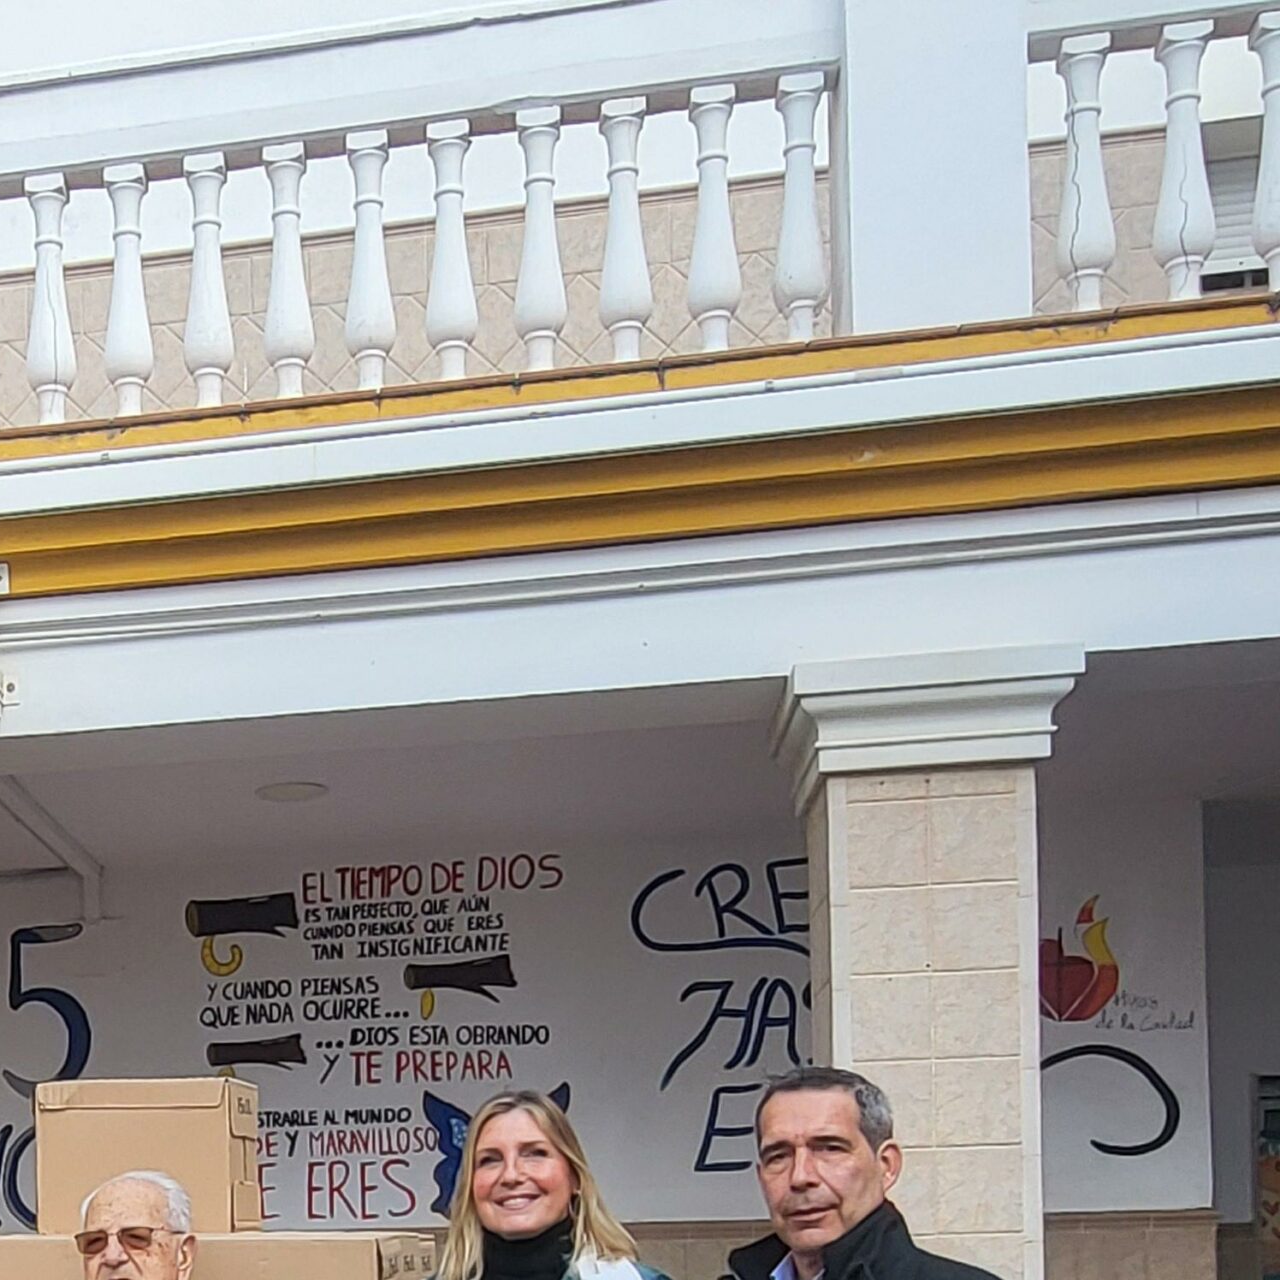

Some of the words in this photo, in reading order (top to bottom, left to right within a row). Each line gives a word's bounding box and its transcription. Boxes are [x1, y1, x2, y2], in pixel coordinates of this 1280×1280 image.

[302, 873, 332, 904] EL
[334, 865, 423, 901] TIEMPO
[431, 861, 466, 894] DE
[478, 854, 564, 892] DIOS
[304, 908, 322, 924] ES
[325, 906, 352, 922] TAN
[420, 899, 450, 916] QUE
[457, 894, 490, 914] AÚN
[303, 922, 357, 941] CUANDO
[358, 918, 415, 937] PIENSAS
[424, 916, 455, 934] QUE
[467, 913, 504, 932] ERES
[311, 943, 344, 961] TAN
[357, 933, 510, 959] INSIGNIFICANTE
[207, 983, 218, 1001] Y
[222, 978, 292, 1001] CUANDO
[301, 976, 380, 998] PIENSAS
[199, 1006, 241, 1030] QUE
[245, 1001, 294, 1025] NADA
[409, 1025, 449, 1047] ESTA
[456, 1024, 551, 1046] OBRANDO
[660, 976, 813, 1091] HA
[319, 1053, 340, 1085] Y
[350, 1051, 382, 1086] TE
[396, 1048, 513, 1084] PREPARA
[324, 1111, 340, 1125] AL
[344, 1107, 412, 1125] MUNDO
[285, 1130, 299, 1157] Y
[309, 1126, 439, 1158] MARAVILLOSO
[307, 1158, 417, 1220] ERES
